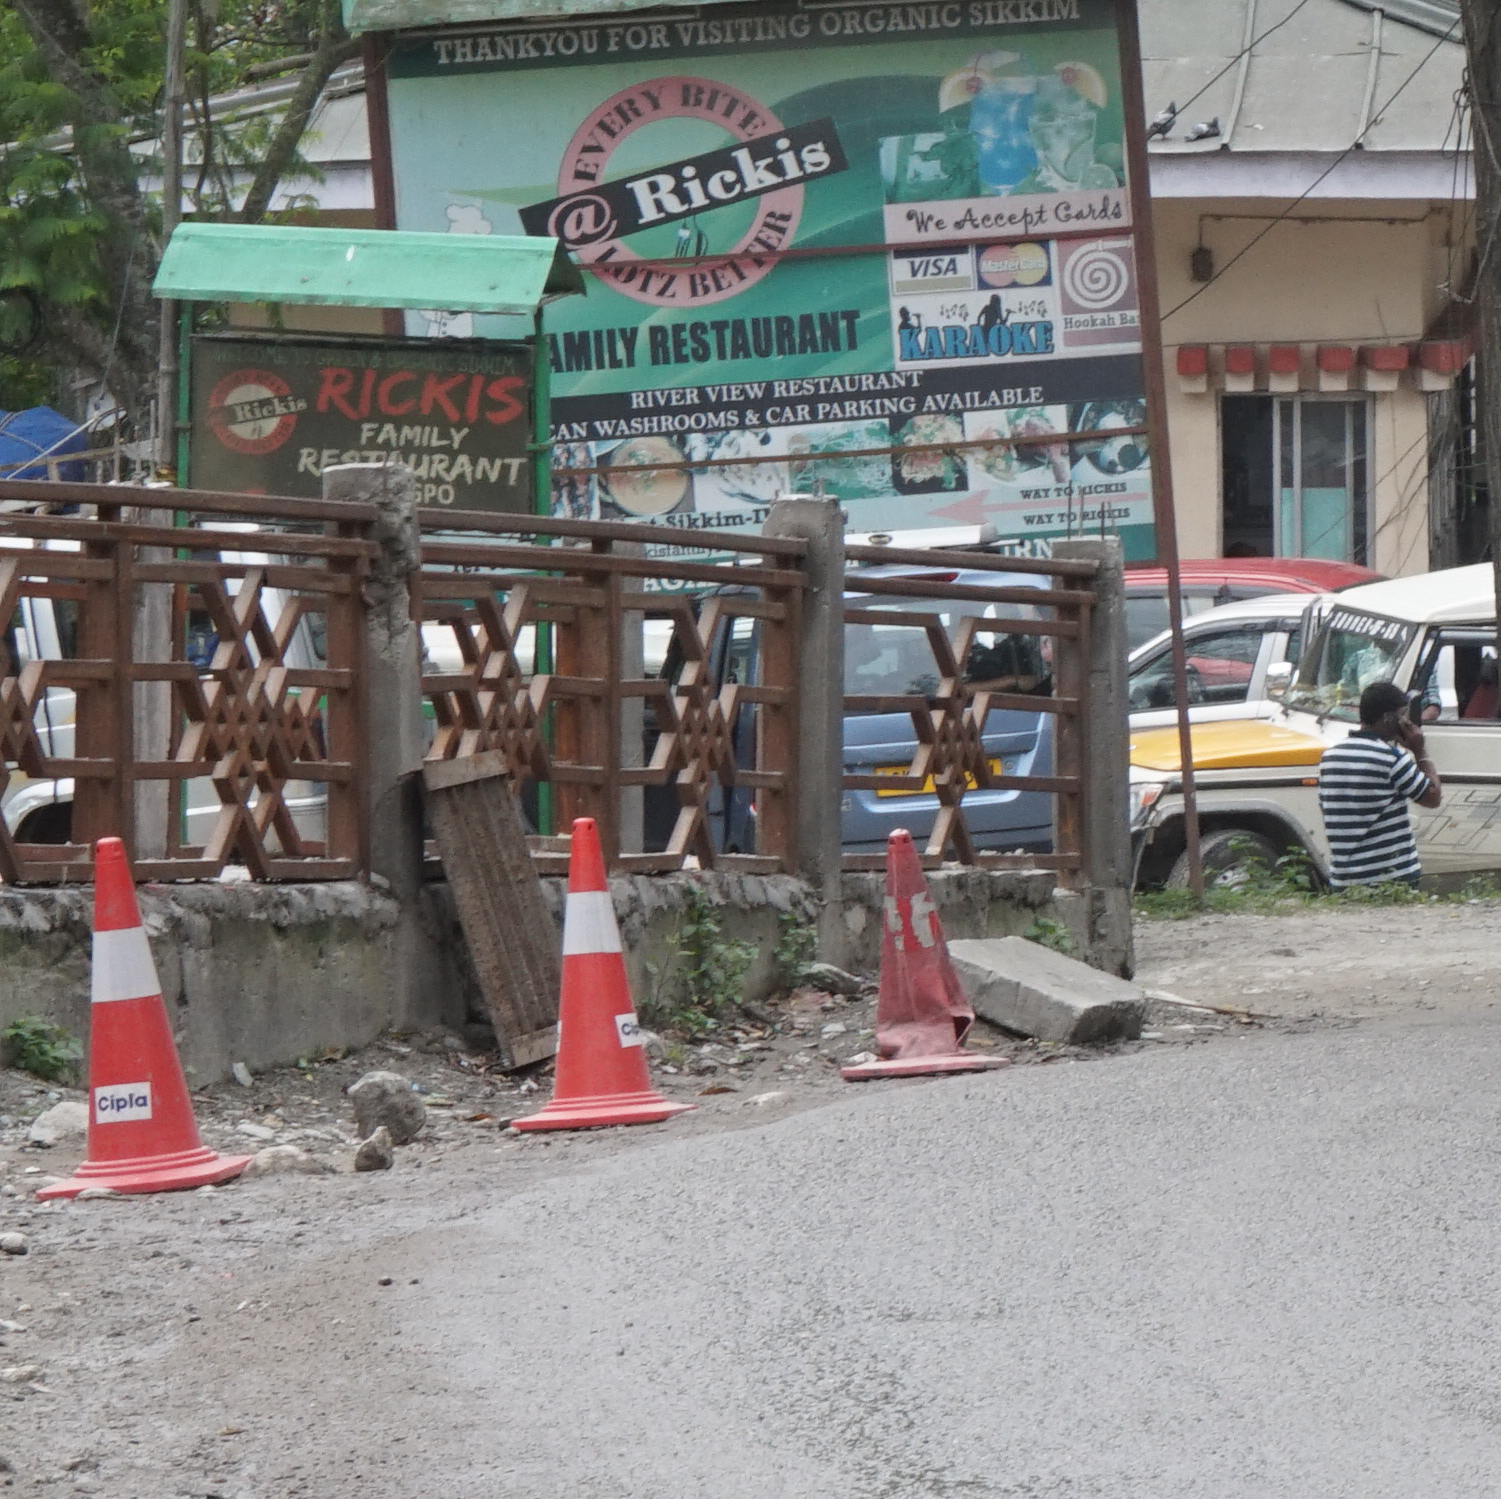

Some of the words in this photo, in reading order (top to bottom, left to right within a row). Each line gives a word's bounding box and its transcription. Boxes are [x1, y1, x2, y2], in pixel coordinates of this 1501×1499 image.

[433, 28, 600, 65] THANKYOU
[607, 24, 671, 51] FOR
[675, 12, 811, 47] VISITING
[819, 4, 961, 37] ORGANIC
[573, 84, 665, 183] EVERY
[680, 83, 768, 139] BITE
[625, 137, 832, 225] Rickis
[906, 208, 947, 234] We
[953, 203, 1048, 234] Accept
[1054, 195, 1123, 222] Cards
[688, 208, 793, 299] BETTER
[907, 257, 959, 279] VISA
[548, 326, 639, 374] AMILY
[649, 309, 860, 367] RESTAURANT
[899, 320, 1056, 362] KARAOKE
[1063, 313, 1116, 330] Hookah
[316, 367, 526, 424] RICKIS
[630, 385, 700, 410] RIVER
[706, 381, 767, 404] VIEW
[772, 370, 924, 399] RESTAURANT
[592, 409, 740, 438] WASHROOMS
[744, 409, 762, 426] &
[765, 404, 813, 424] CAR
[817, 397, 919, 420] PARKING
[921, 386, 1045, 412] AVAILABLE
[360, 422, 470, 450] FAMILY
[297, 446, 529, 486] RESTAURANT
[1020, 485, 1051, 500] WAY
[1055, 484, 1074, 497] TO
[1023, 512, 1055, 525] WAY
[1058, 511, 1077, 523] TO
[98, 1092, 148, 1113] Cipla
